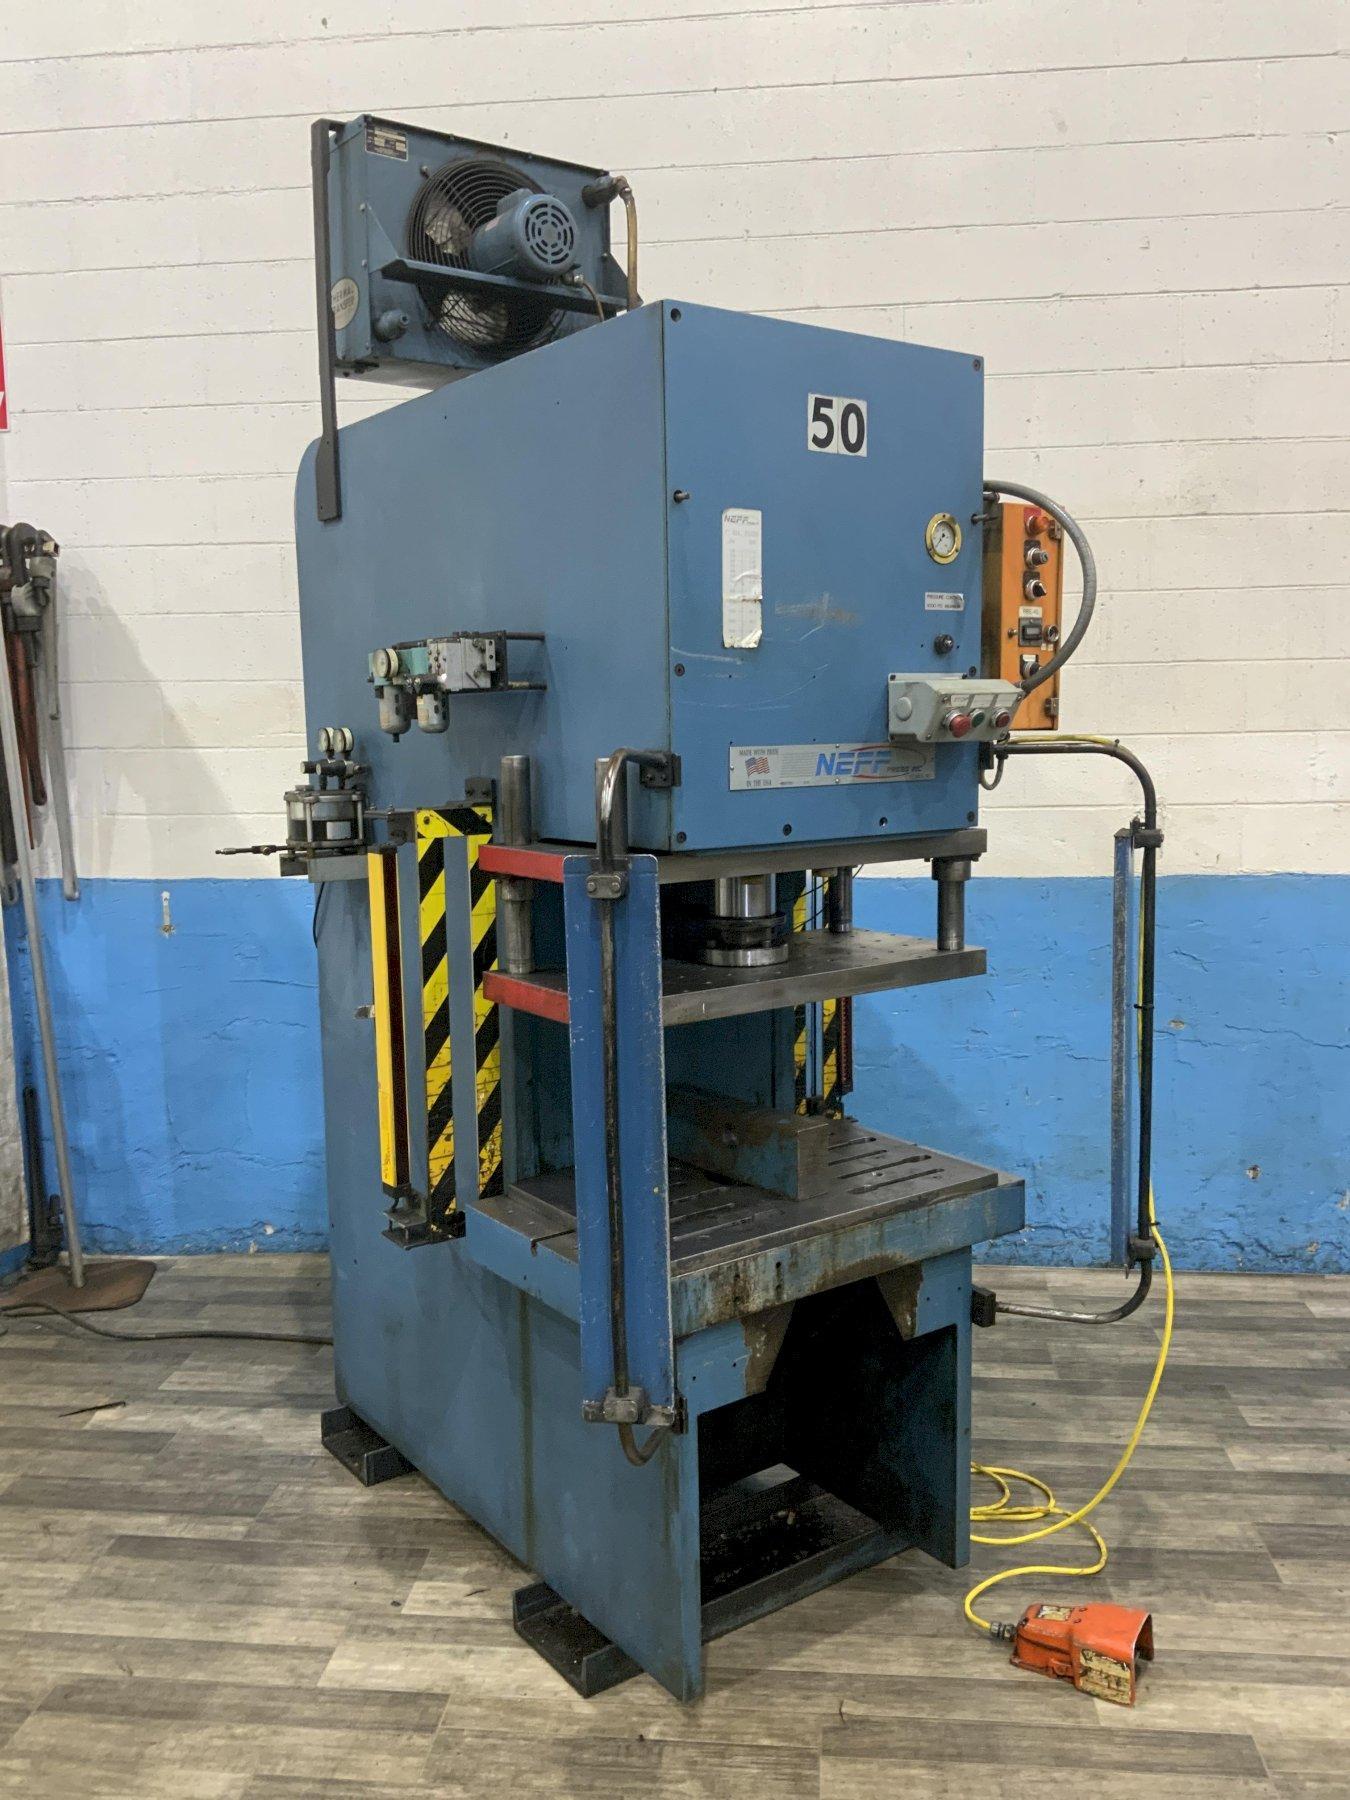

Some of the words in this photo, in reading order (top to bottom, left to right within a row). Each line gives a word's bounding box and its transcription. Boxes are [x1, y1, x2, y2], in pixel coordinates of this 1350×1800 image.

[812, 397, 865, 453] 50
[724, 515, 749, 525] NEFF
[815, 751, 891, 776] NEFF
